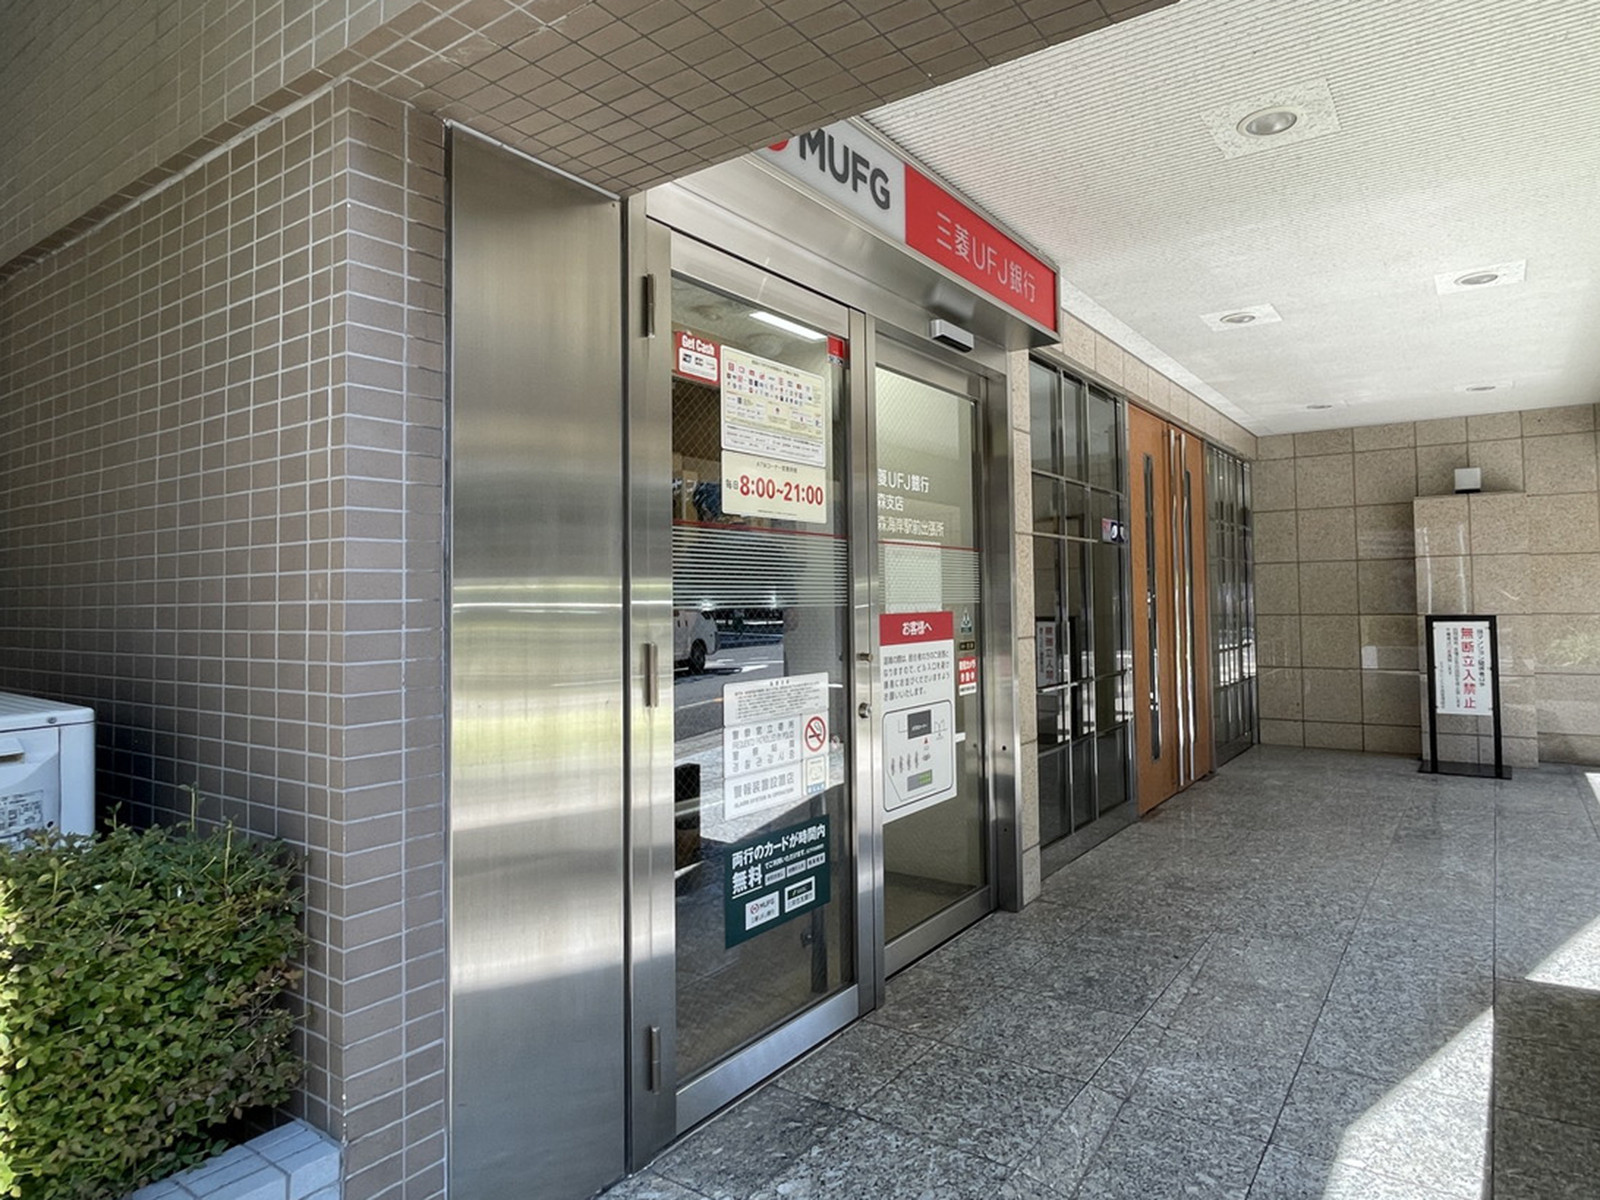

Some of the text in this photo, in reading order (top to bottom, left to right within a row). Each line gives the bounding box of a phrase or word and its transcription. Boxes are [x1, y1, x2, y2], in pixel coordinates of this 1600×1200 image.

[799, 128, 890, 210] MUFG
[936, 211, 1035, 302] 三菱UFJ銀行
[1461, 627, 1476, 709] 無断立入禁止
[732, 823, 826, 870] 両行のカードが時間内
[732, 863, 763, 895] 無料
